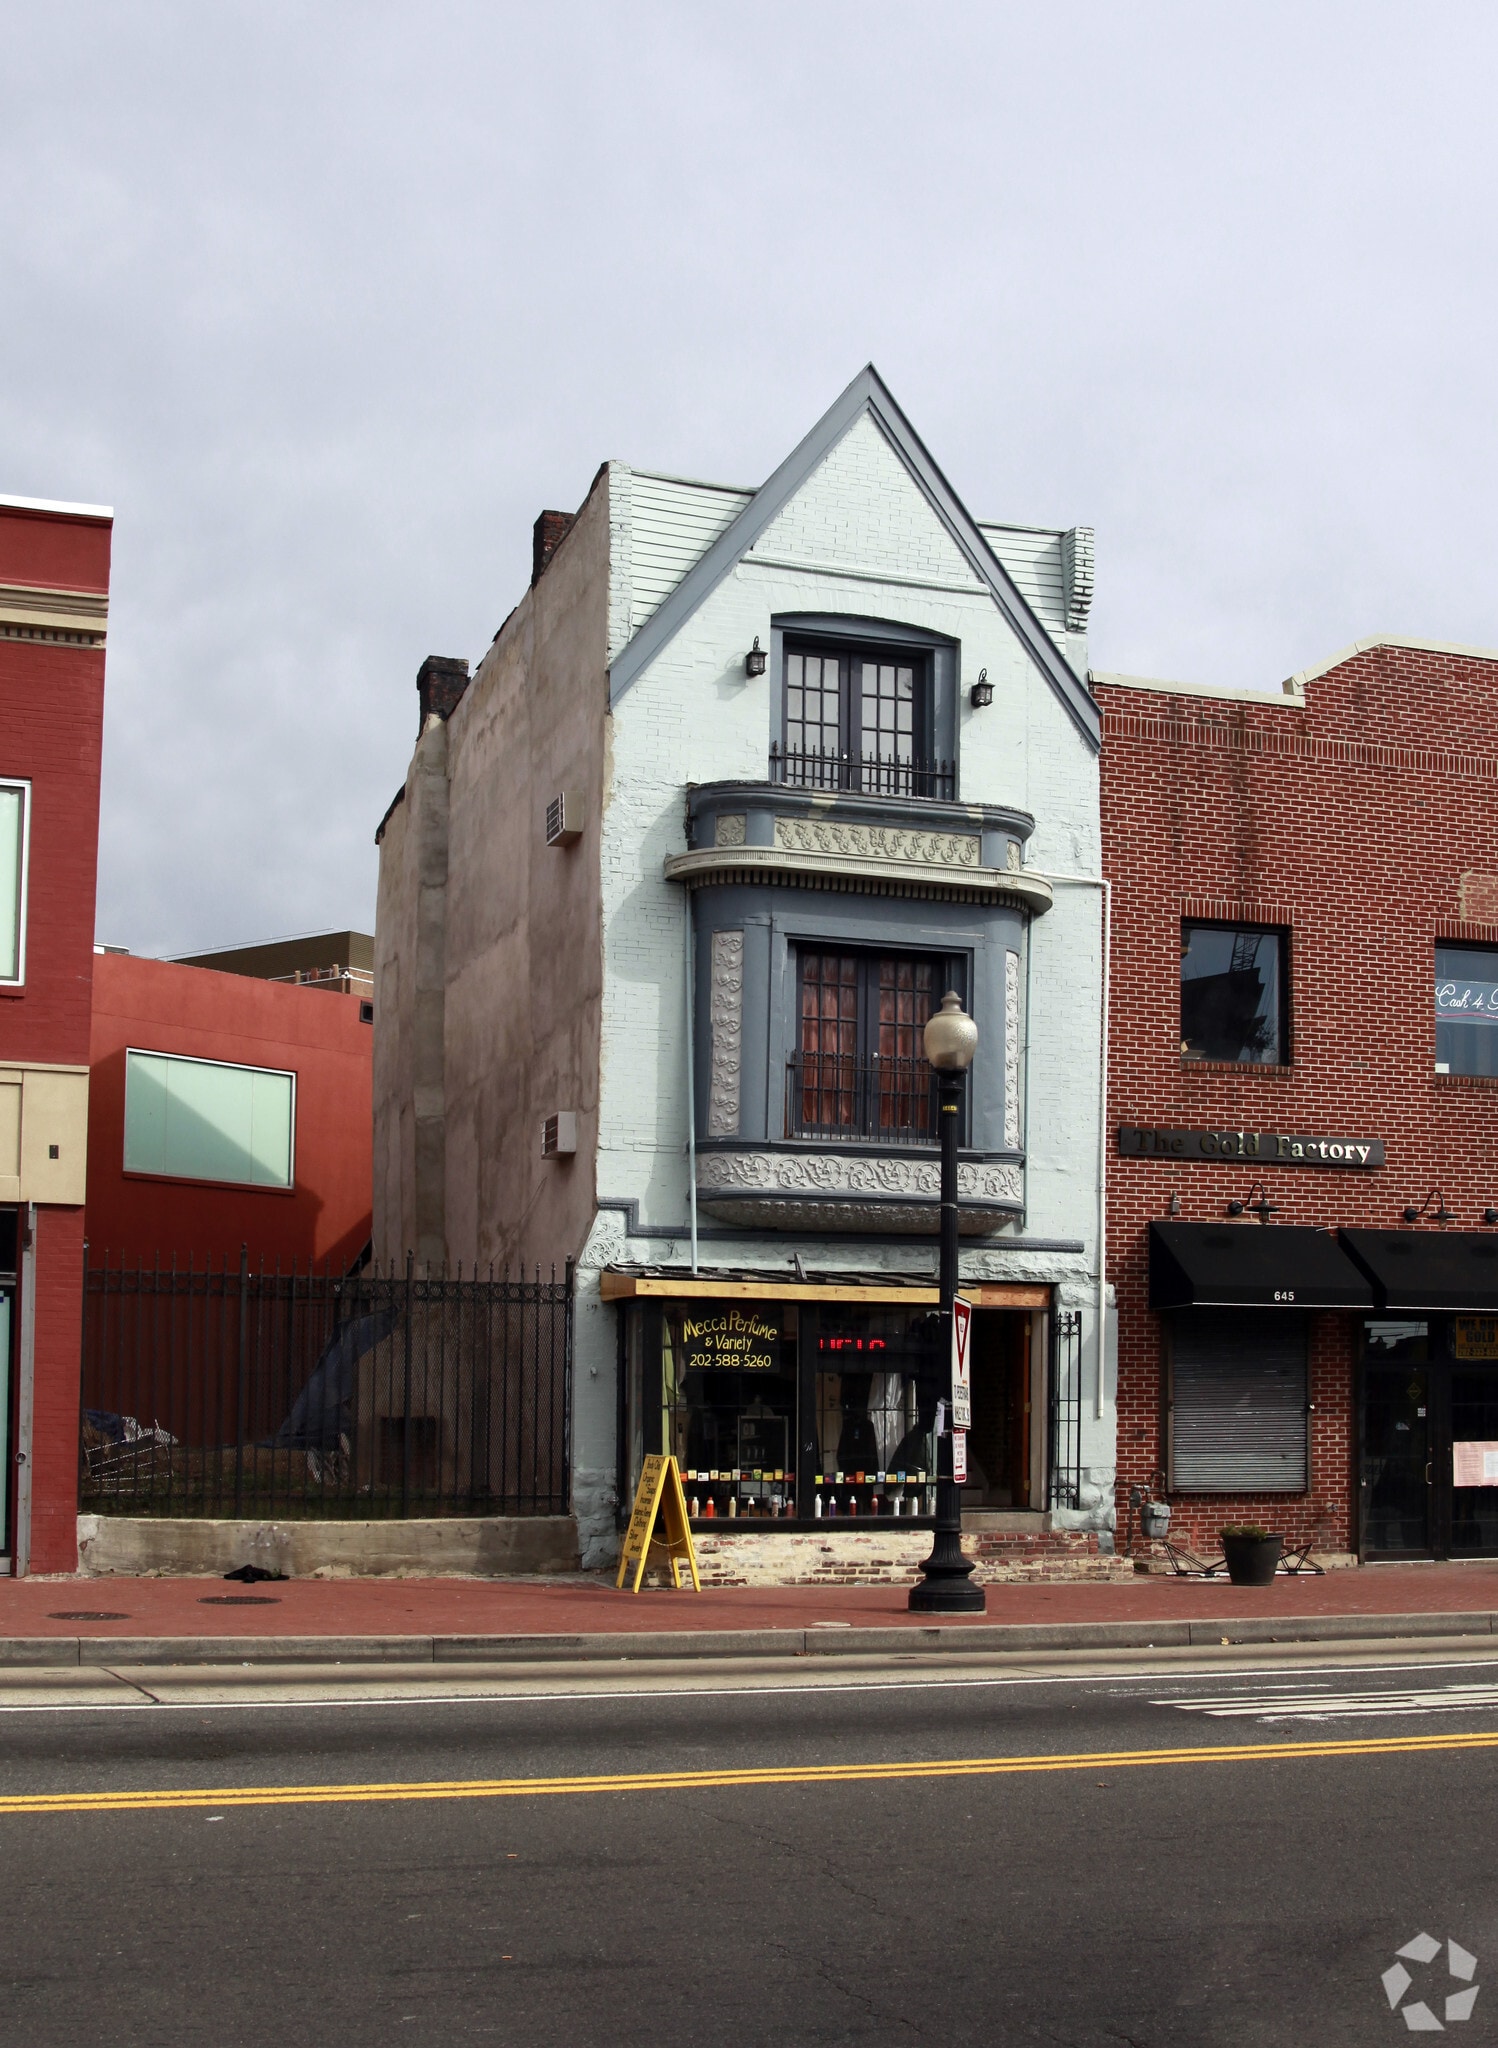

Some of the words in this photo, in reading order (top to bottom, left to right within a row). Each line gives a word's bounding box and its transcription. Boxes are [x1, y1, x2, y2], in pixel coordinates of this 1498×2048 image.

[1435, 984, 1471, 1009] Cash
[1472, 993, 1484, 1009] 4
[1134, 1130, 1184, 1154] The
[1200, 1132, 1260, 1157] Gold
[1275, 1135, 1371, 1163] Factory
[1274, 1291, 1295, 1301] 645
[683, 1317, 727, 1343] Mecca
[729, 1310, 778, 1341] Perfume
[705, 1337, 713, 1347] &
[715, 1334, 753, 1352] Variety
[1466, 1331, 1495, 1343] GOLD
[689, 1354, 772, 1367] 202-588-5260
